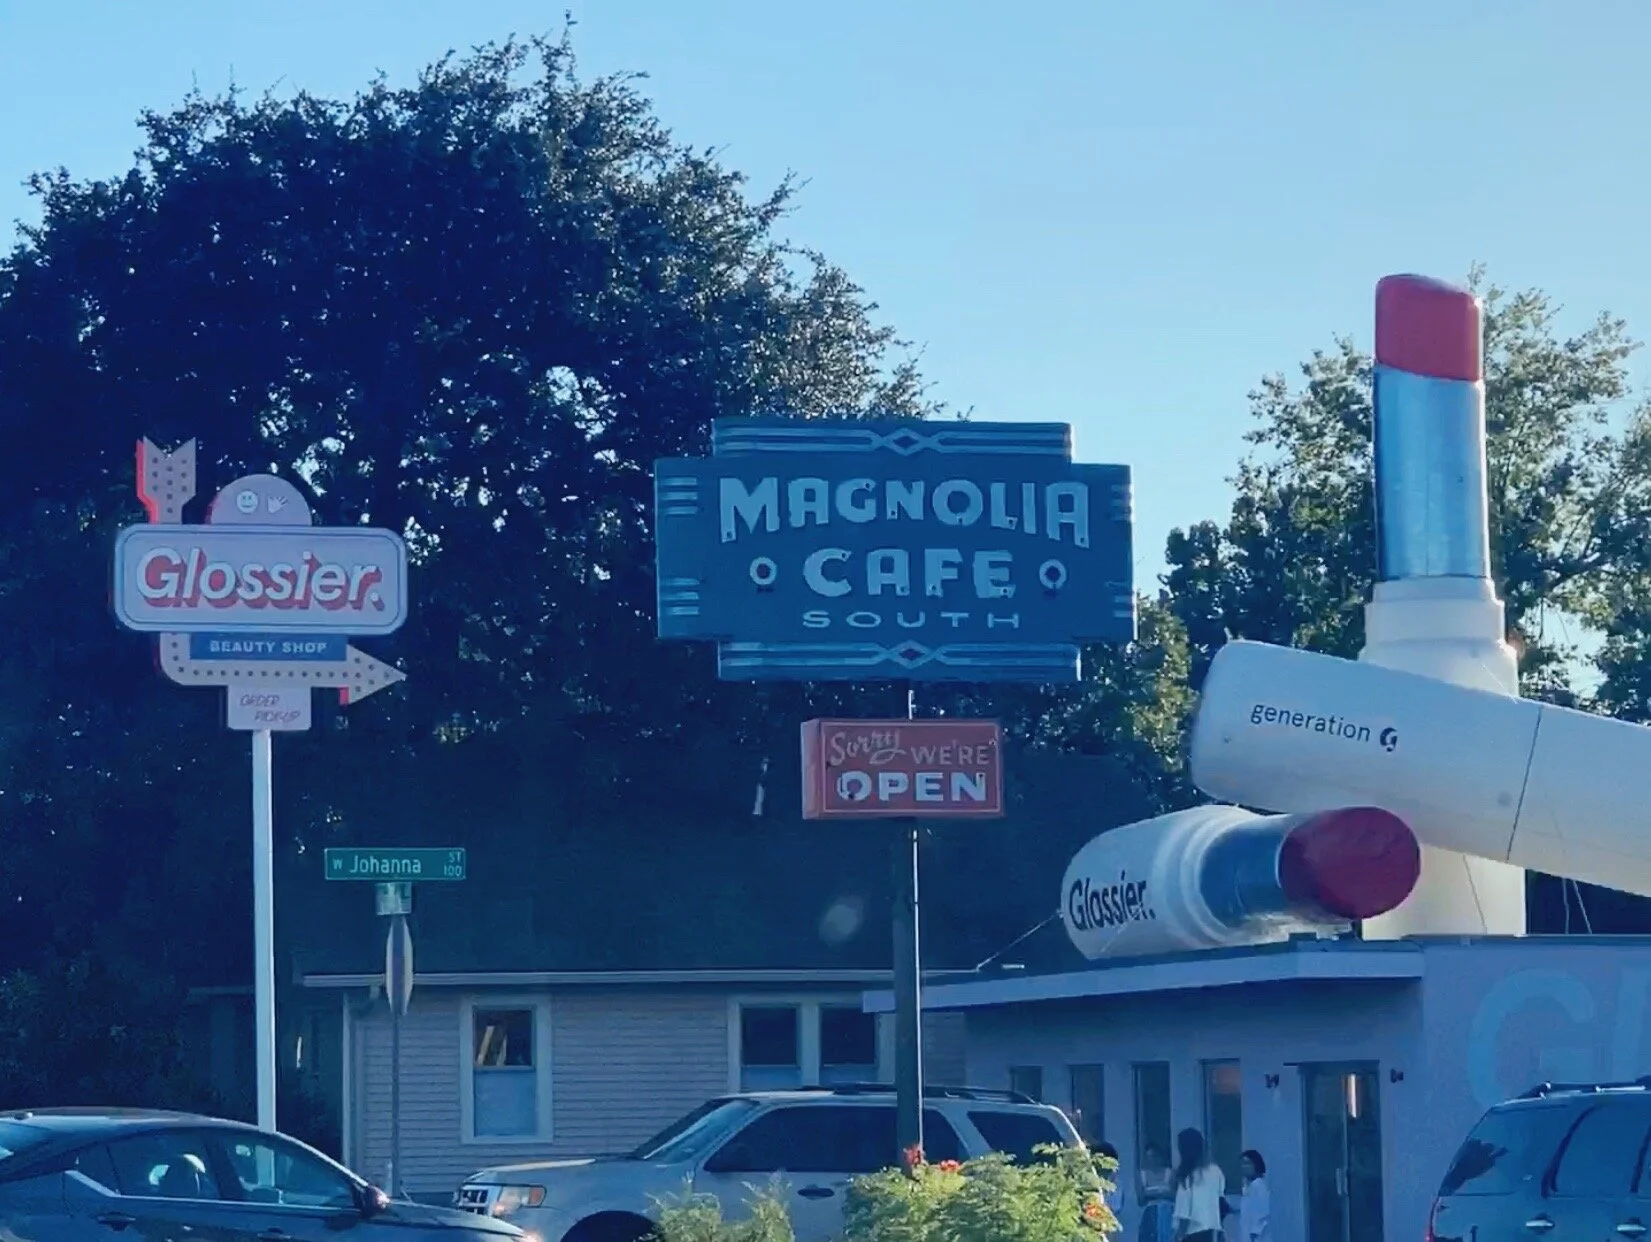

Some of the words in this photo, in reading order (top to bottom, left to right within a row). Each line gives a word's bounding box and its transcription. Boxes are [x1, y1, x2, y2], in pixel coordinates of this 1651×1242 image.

[720, 476, 1090, 548] MAGNOLIA
[136, 547, 385, 610] Glossier.
[803, 548, 1016, 598] CAFE
[803, 611, 1019, 628] SOUTH
[210, 640, 276, 653] BEAUTY
[282, 641, 327, 654] SHOP
[1250, 703, 1371, 743] generation
[830, 728, 907, 765] Sorry
[911, 740, 990, 765] WE'RE
[836, 770, 987, 802] OPEN
[332, 858, 343, 870] W
[350, 855, 422, 873] Johanna
[449, 852, 462, 863] ST
[443, 865, 462, 876] 100
